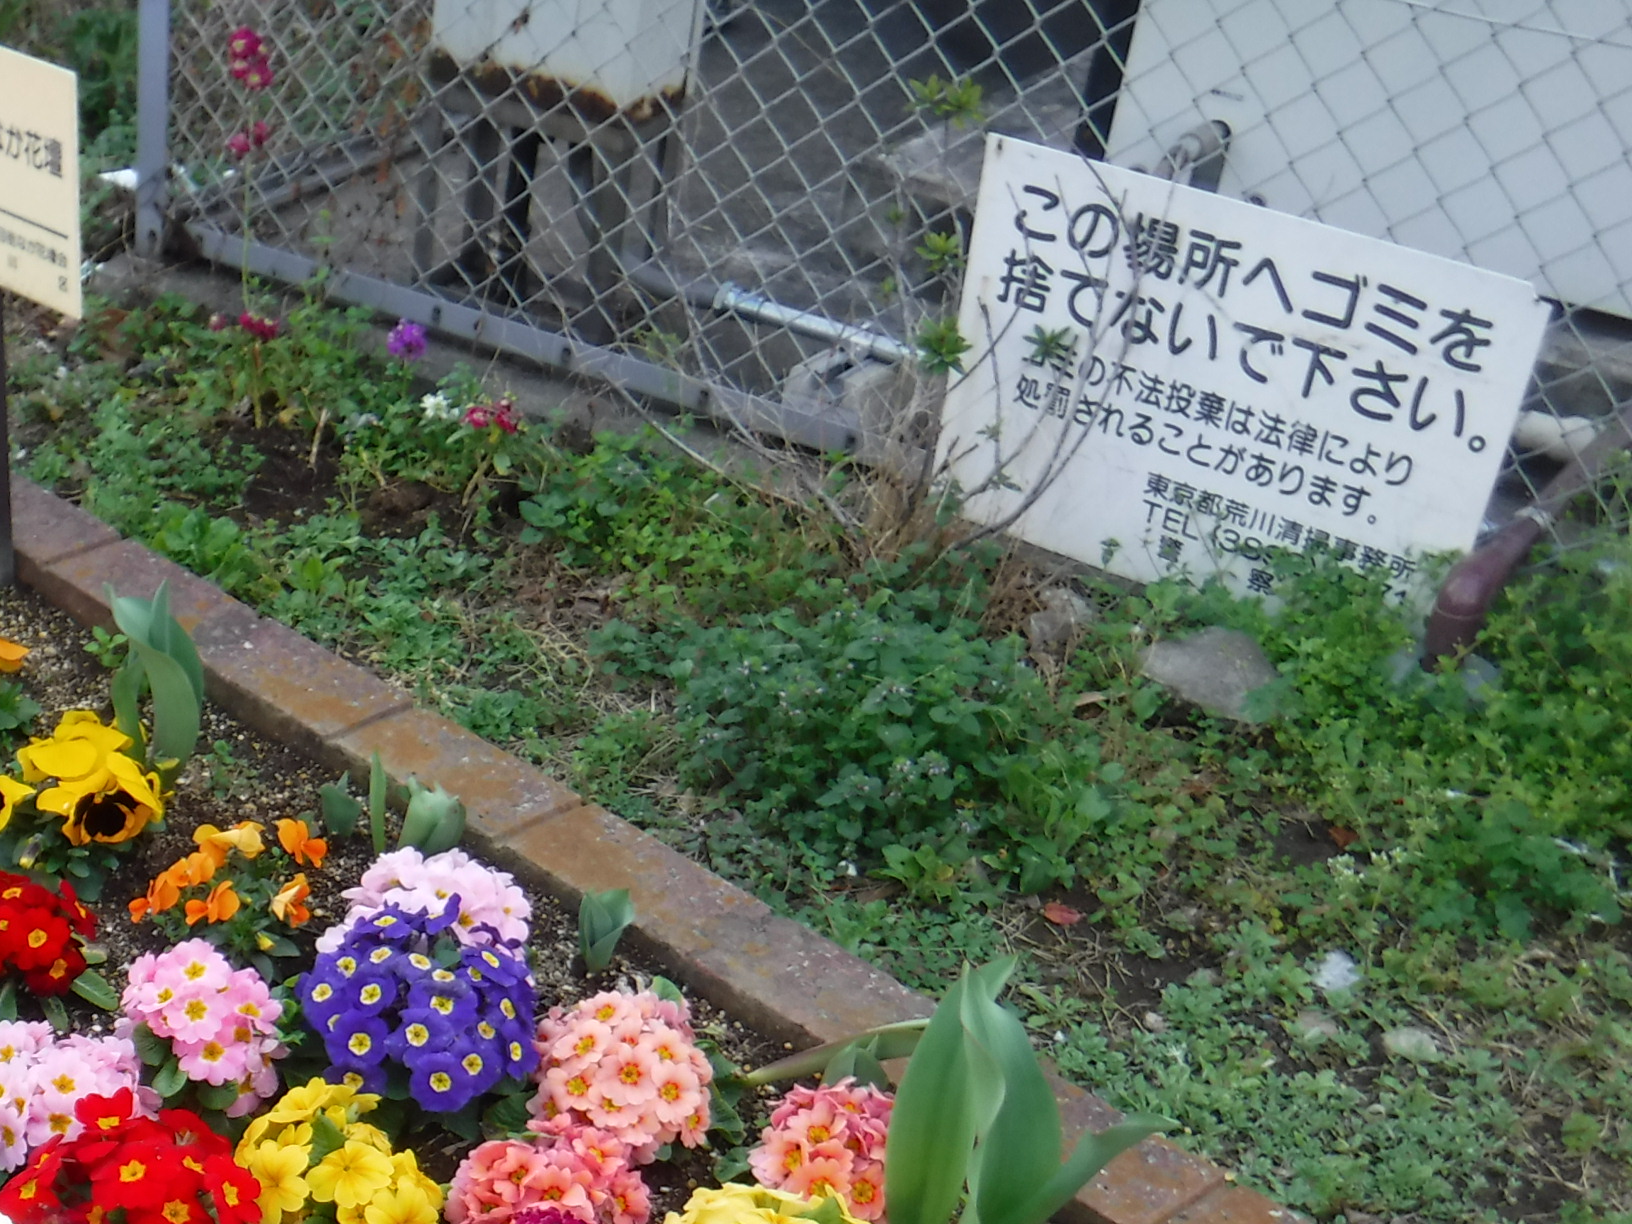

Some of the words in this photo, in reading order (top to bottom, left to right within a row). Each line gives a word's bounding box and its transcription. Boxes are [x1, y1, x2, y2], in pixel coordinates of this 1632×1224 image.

[998, 249, 1488, 453] 捨てないで下さい。
[1016, 184, 1494, 373] この場所へゴミを
